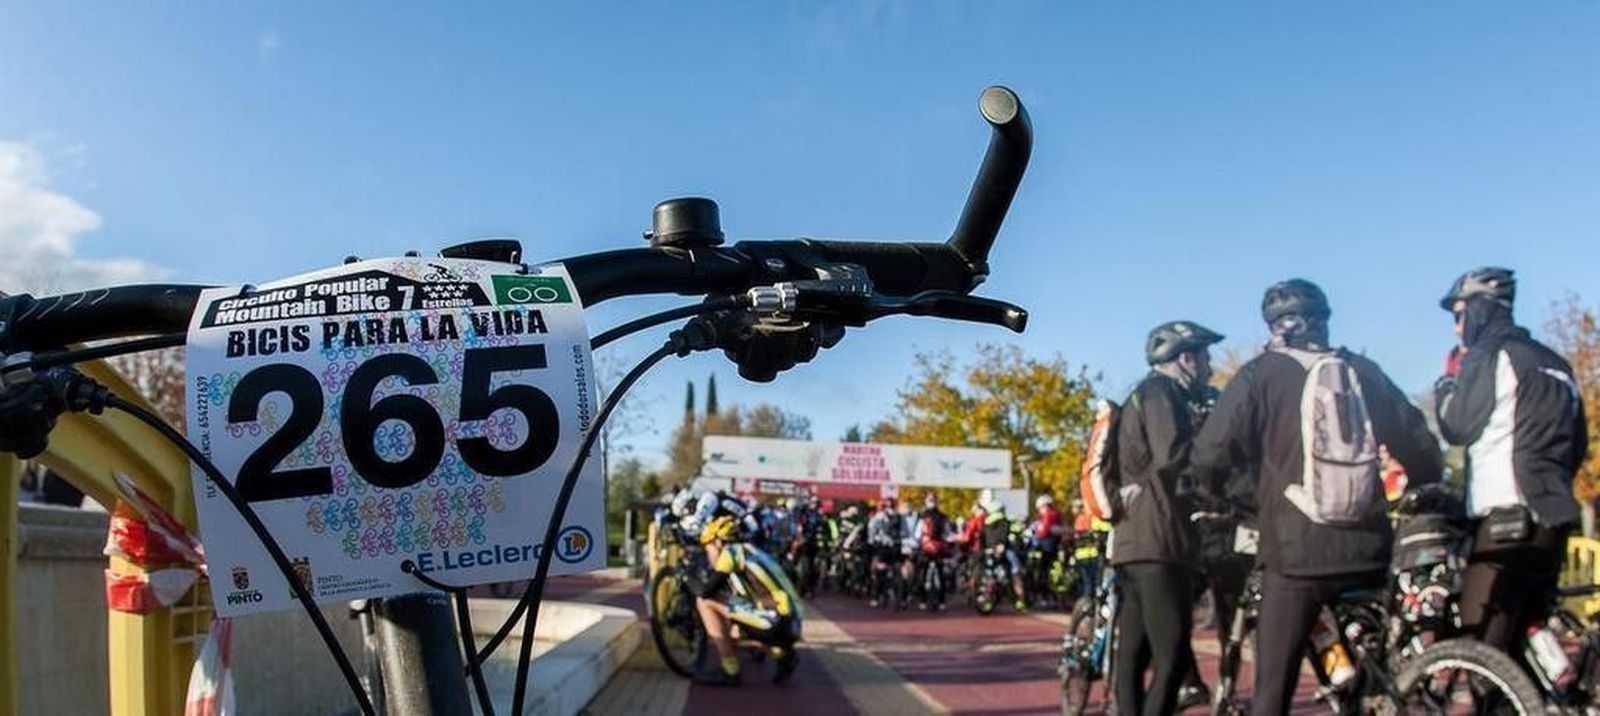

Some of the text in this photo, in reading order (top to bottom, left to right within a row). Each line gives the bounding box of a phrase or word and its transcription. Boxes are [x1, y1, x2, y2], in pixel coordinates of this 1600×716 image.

[214, 285, 415, 325] Mountain Bike 7
[218, 276, 389, 311] Circuito Popular
[422, 299, 474, 309] Estrellas
[226, 308, 548, 358] BICIS PARA LA VIDA
[228, 343, 560, 504] 265
[837, 455, 885, 468] CICLISTA
[831, 467, 891, 481] SOLIDARIA
[226, 592, 263, 605] PINTO
